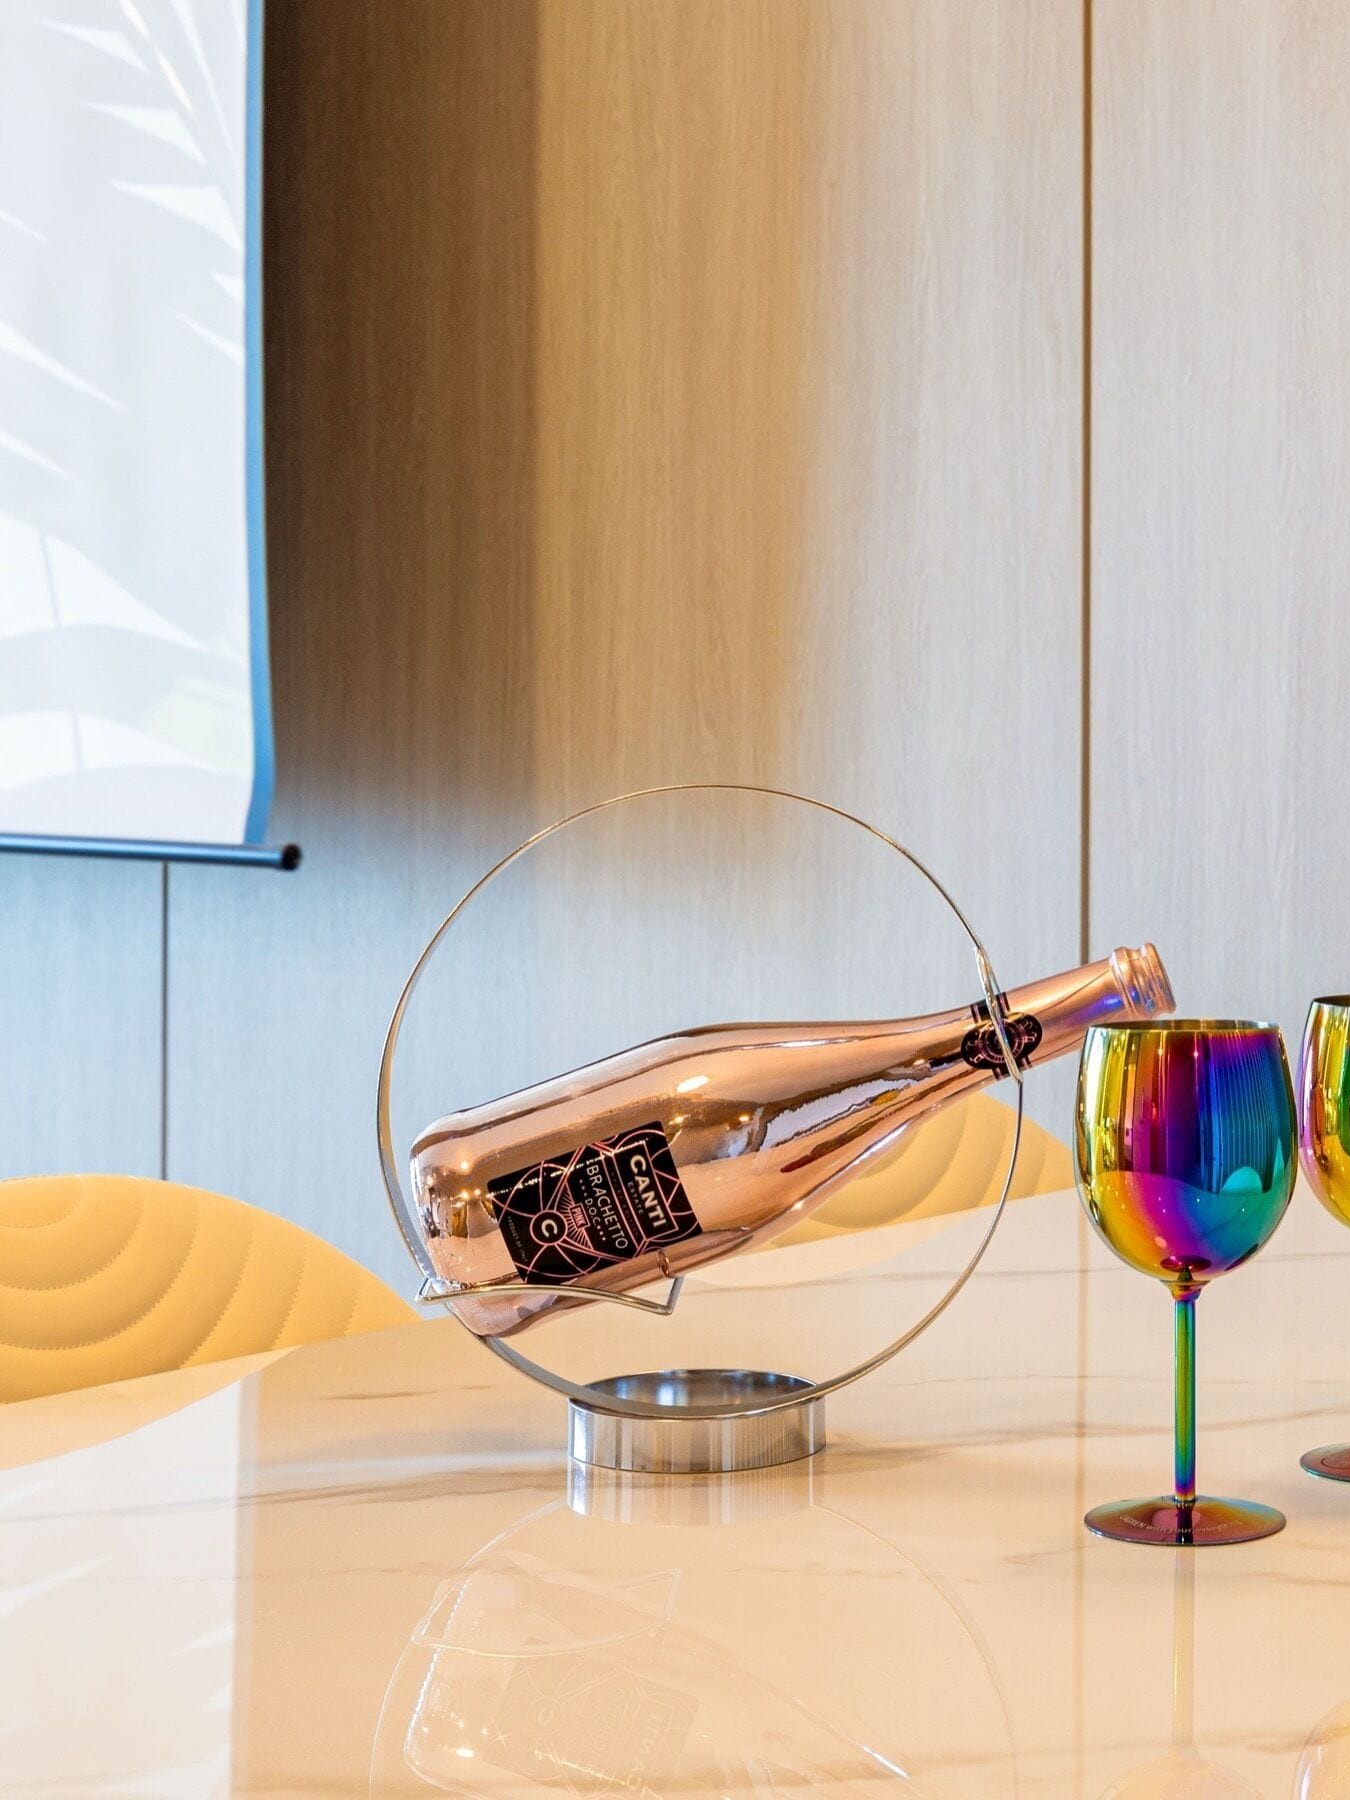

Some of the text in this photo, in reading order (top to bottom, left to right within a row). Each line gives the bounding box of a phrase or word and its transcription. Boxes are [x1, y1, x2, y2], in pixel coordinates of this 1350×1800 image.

[586, 1165, 628, 1249] BRACHETTO
[627, 1180, 644, 1215] ESTATE
[630, 1154, 667, 1228] CANTI
[541, 1219, 558, 1238] C
[572, 1207, 586, 1227] PINK
